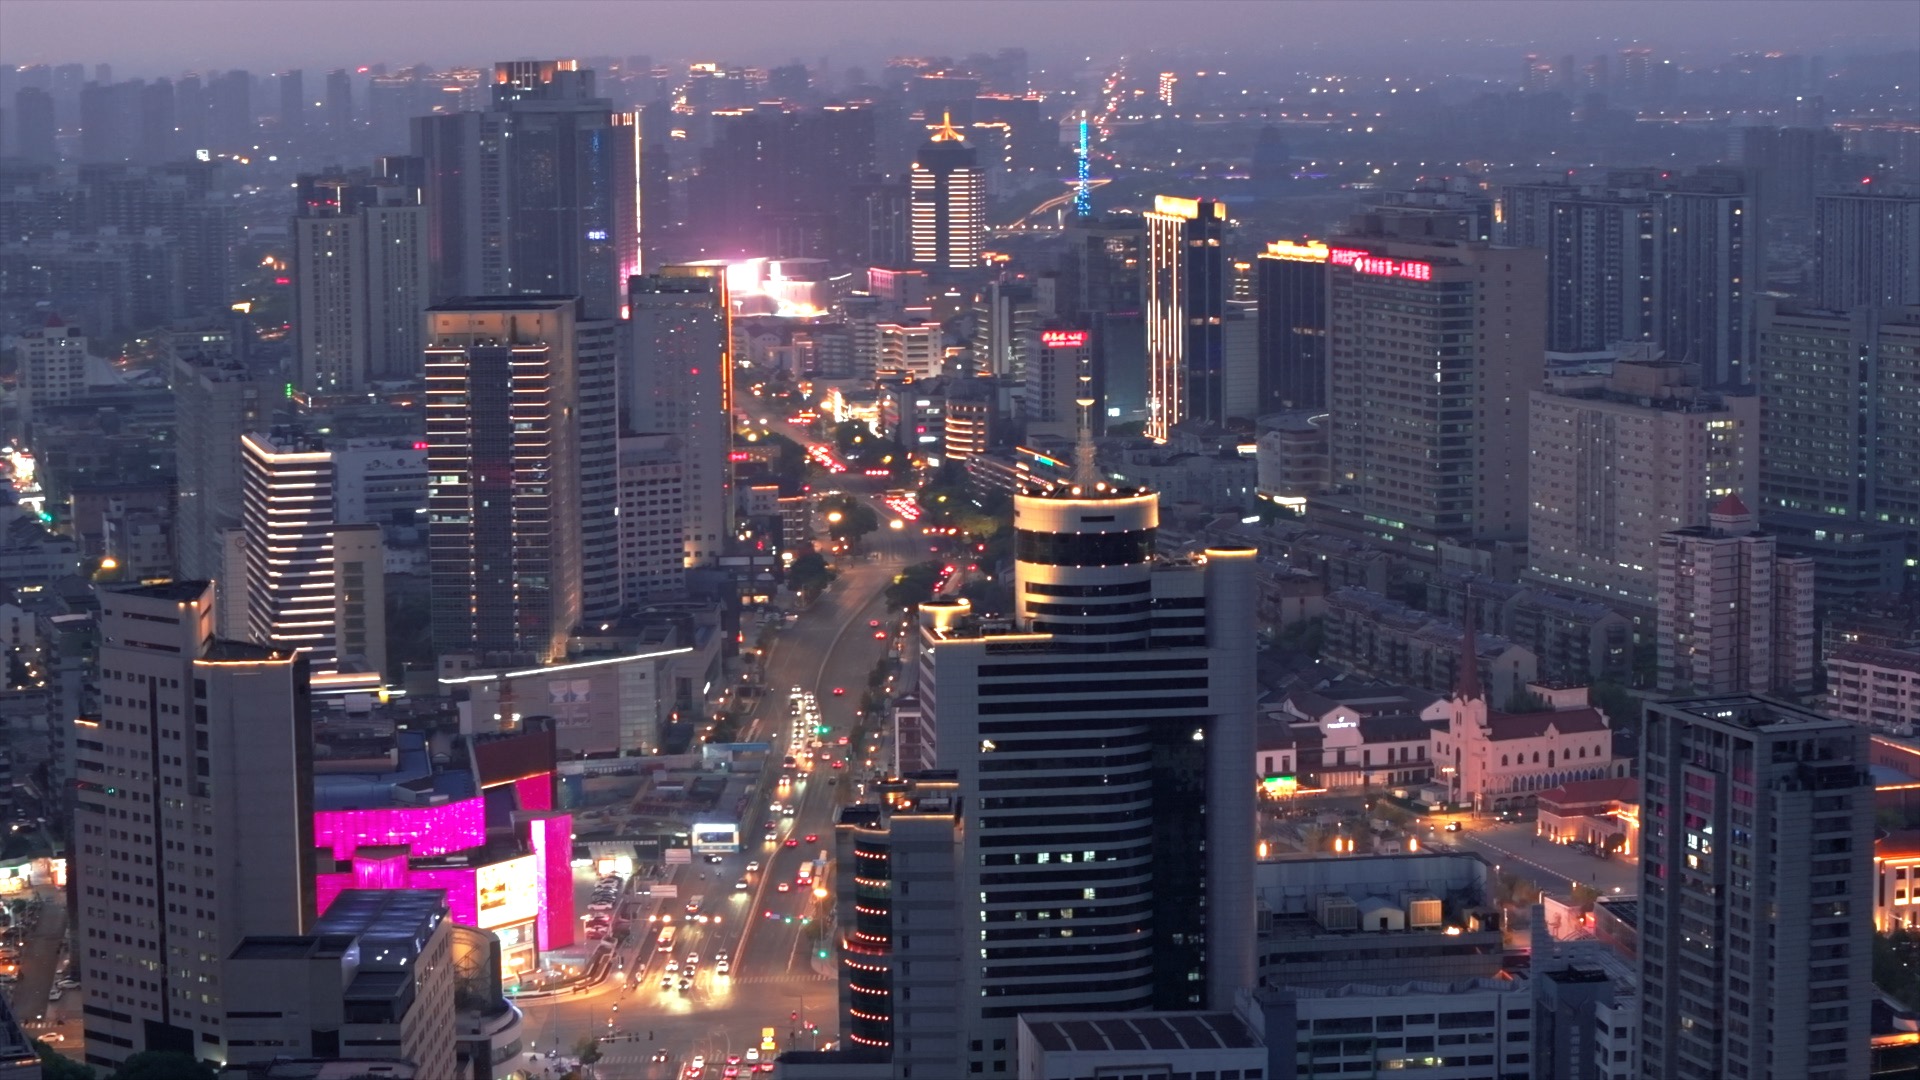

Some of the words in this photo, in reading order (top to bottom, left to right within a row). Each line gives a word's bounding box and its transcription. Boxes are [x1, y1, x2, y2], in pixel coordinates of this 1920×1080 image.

[1364, 258, 1430, 280] 常州市第一人民医院
